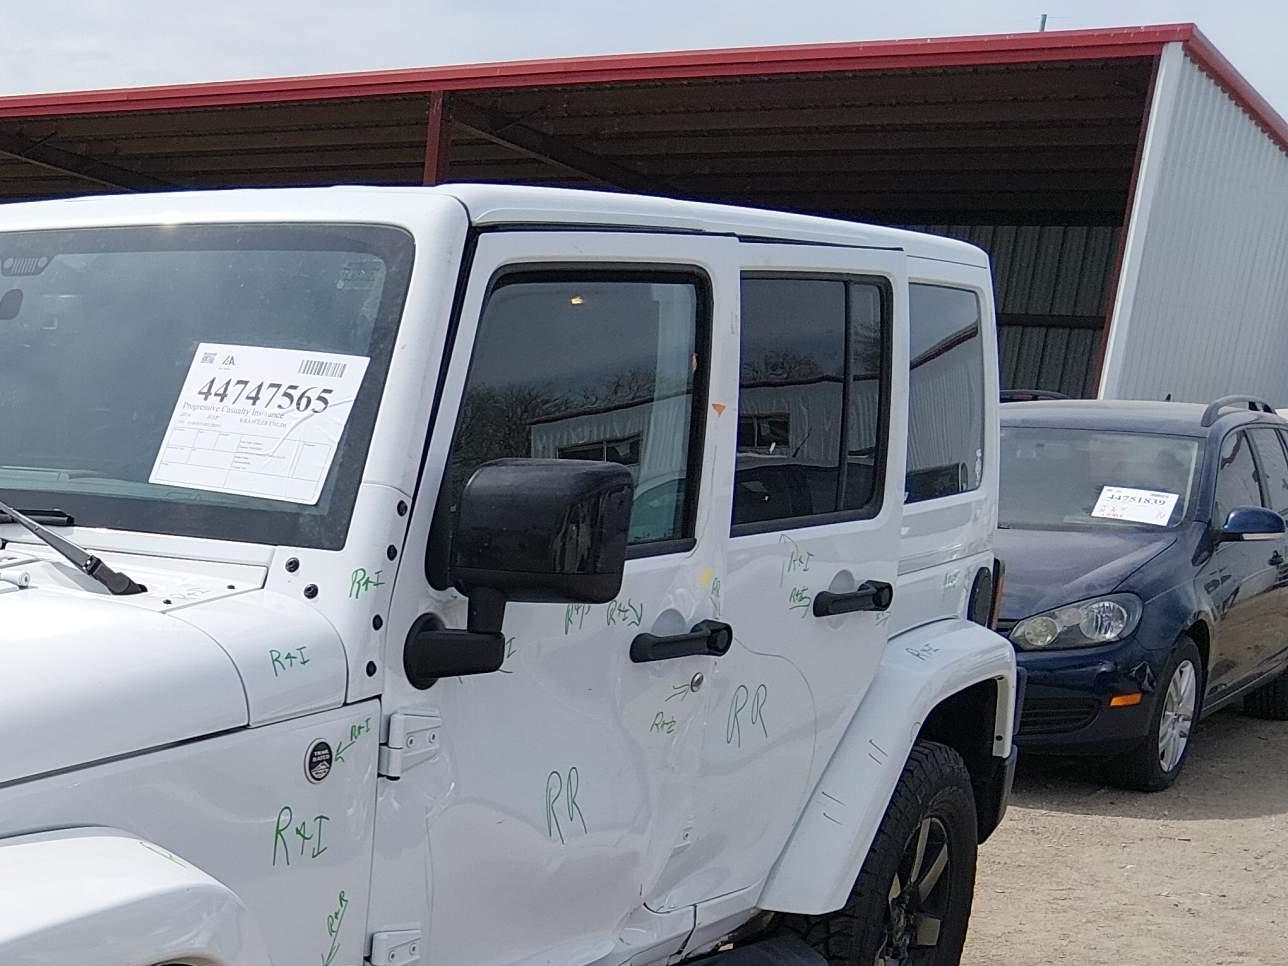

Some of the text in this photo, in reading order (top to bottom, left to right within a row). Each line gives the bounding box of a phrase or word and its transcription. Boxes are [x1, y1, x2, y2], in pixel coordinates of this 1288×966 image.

[198, 377, 334, 414] 44747565
[726, 683, 768, 748] RR
[545, 766, 588, 845] RR
